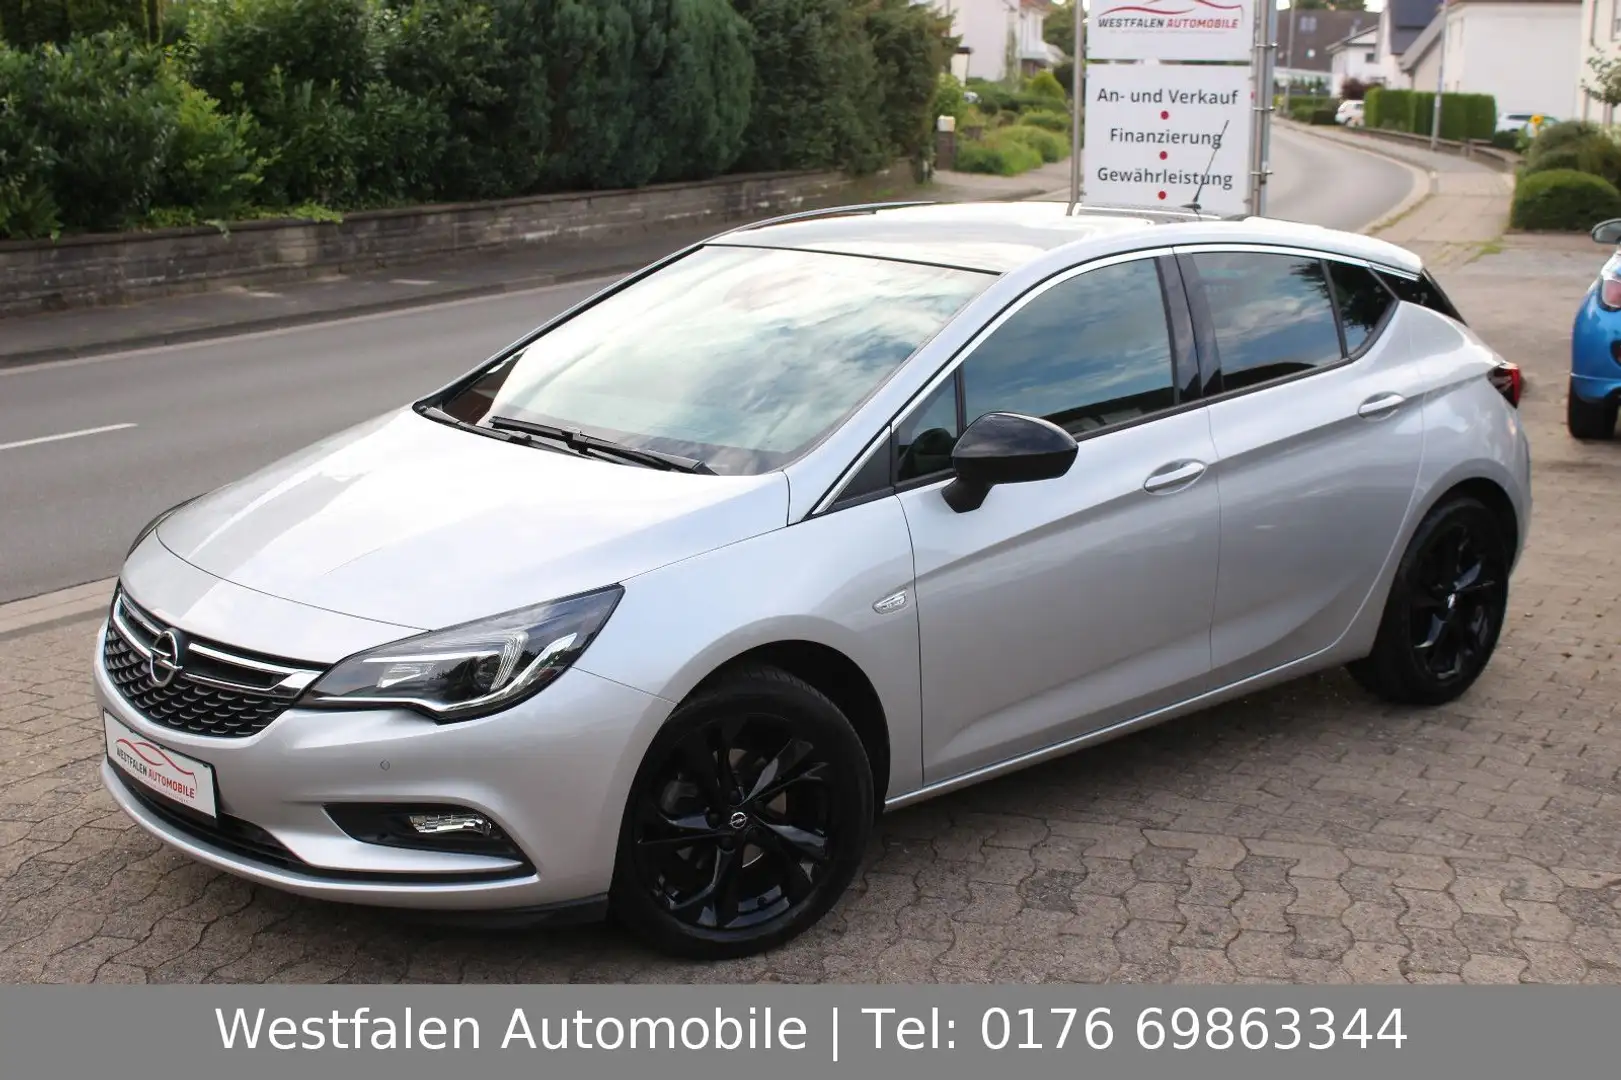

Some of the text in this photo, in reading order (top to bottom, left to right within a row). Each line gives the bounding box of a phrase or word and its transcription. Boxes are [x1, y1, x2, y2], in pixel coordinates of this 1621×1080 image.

[1098, 18, 1239, 29] WESTFALEN AUTOMOBILE
[1097, 87, 1239, 105] An- und Verkauf
[1110, 128, 1222, 150] Finanzierung
[1097, 167, 1233, 190] Gewährleistung
[116, 746, 148, 776] WESTFALEN
[148, 768, 195, 799] AUTOMOBILE
